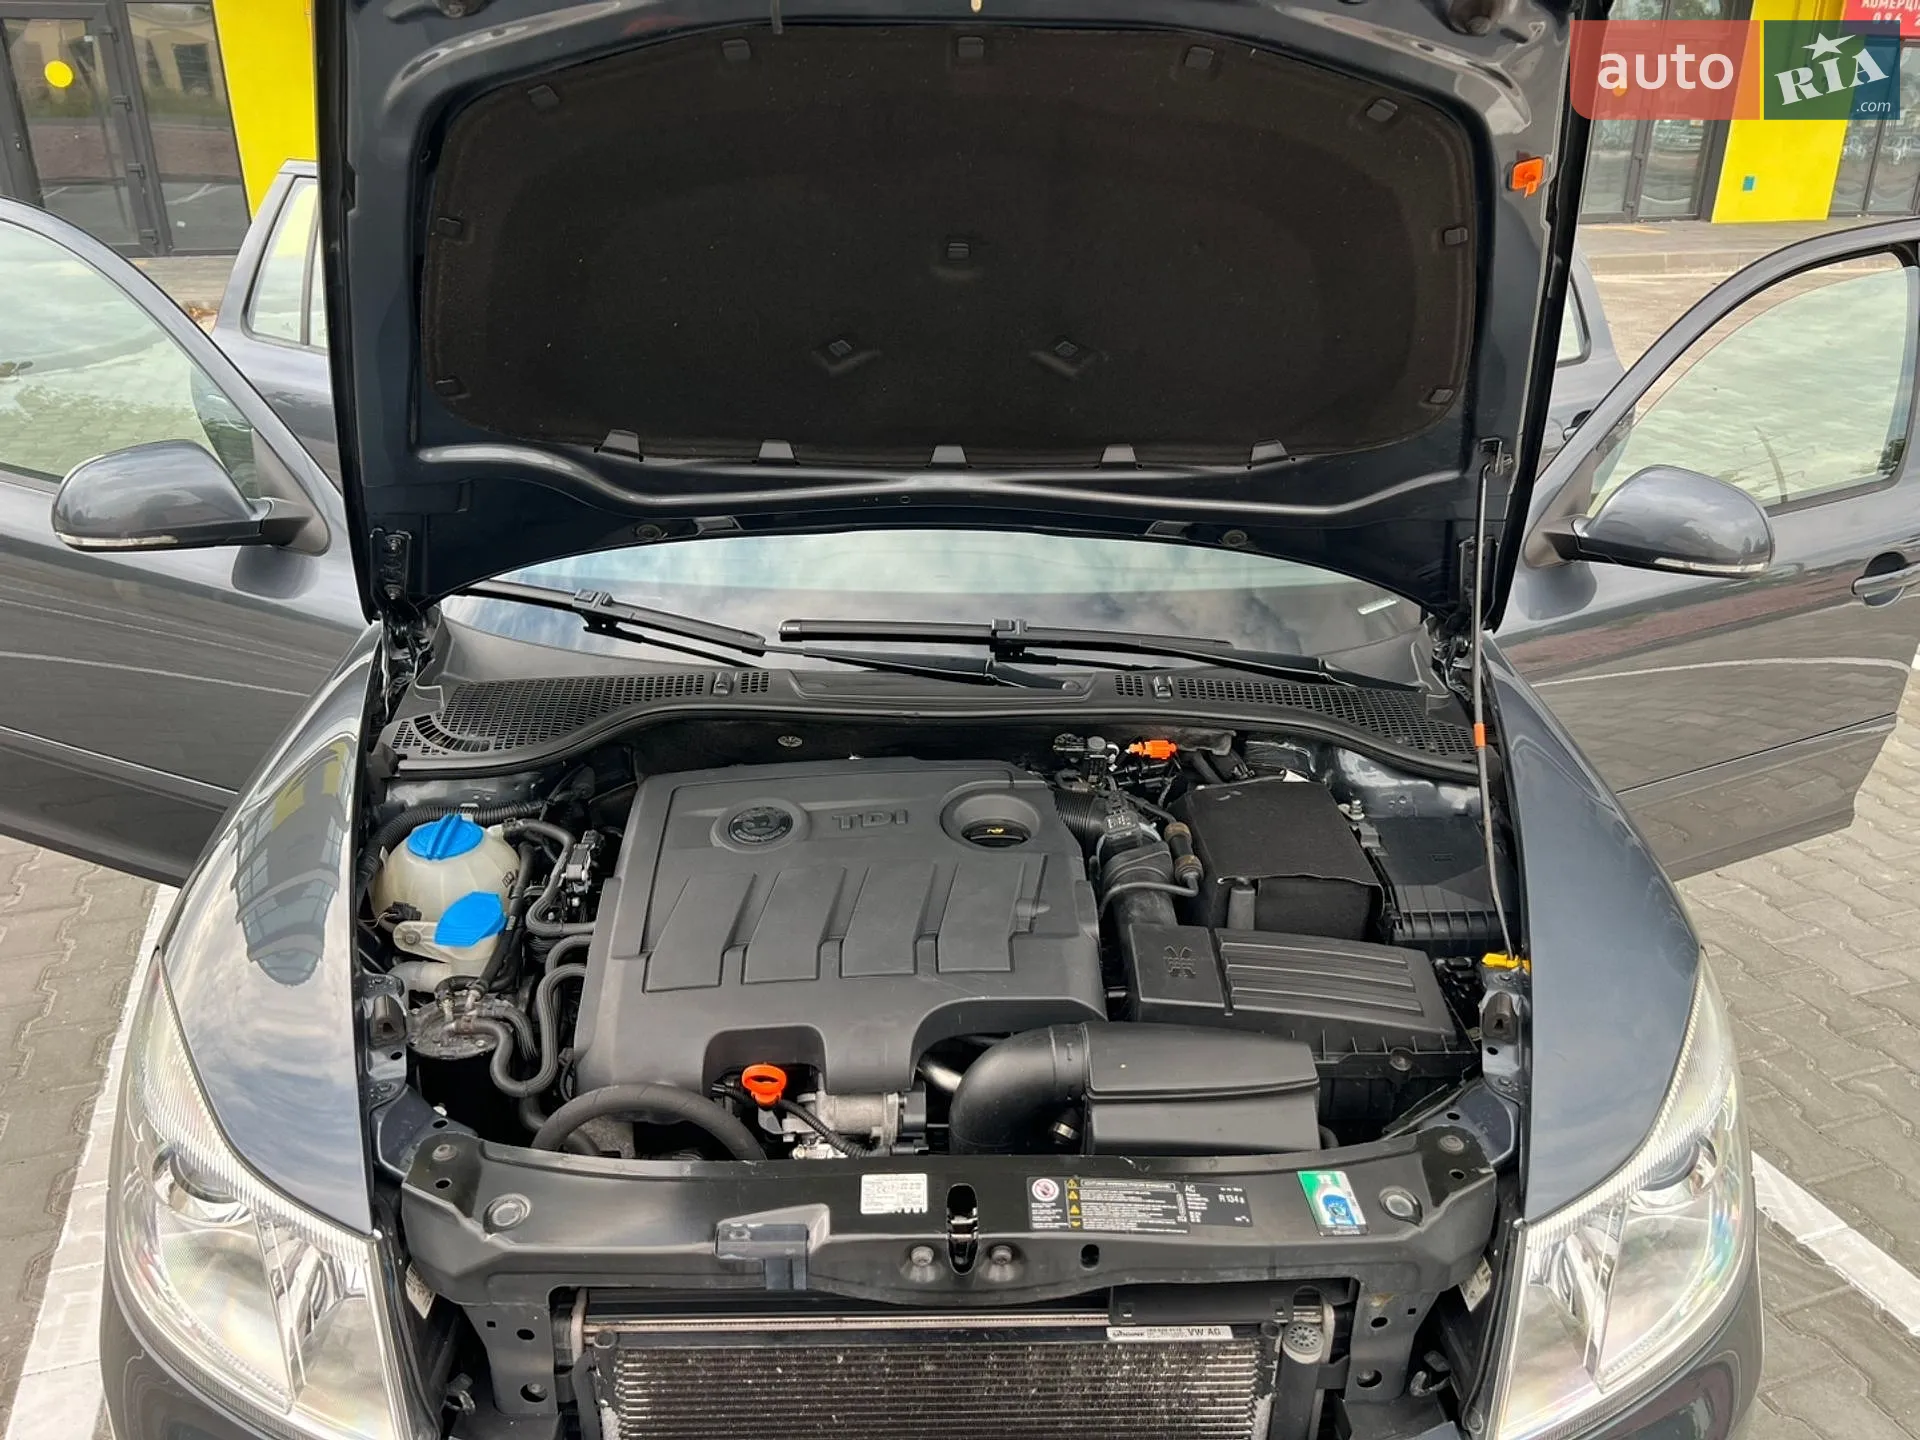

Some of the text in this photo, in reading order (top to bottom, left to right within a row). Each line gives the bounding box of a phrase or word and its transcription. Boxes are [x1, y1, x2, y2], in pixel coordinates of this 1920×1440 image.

[832, 808, 909, 829] TDI
[1187, 1328, 1204, 1336] VW
[1207, 1328, 1221, 1336] AG
